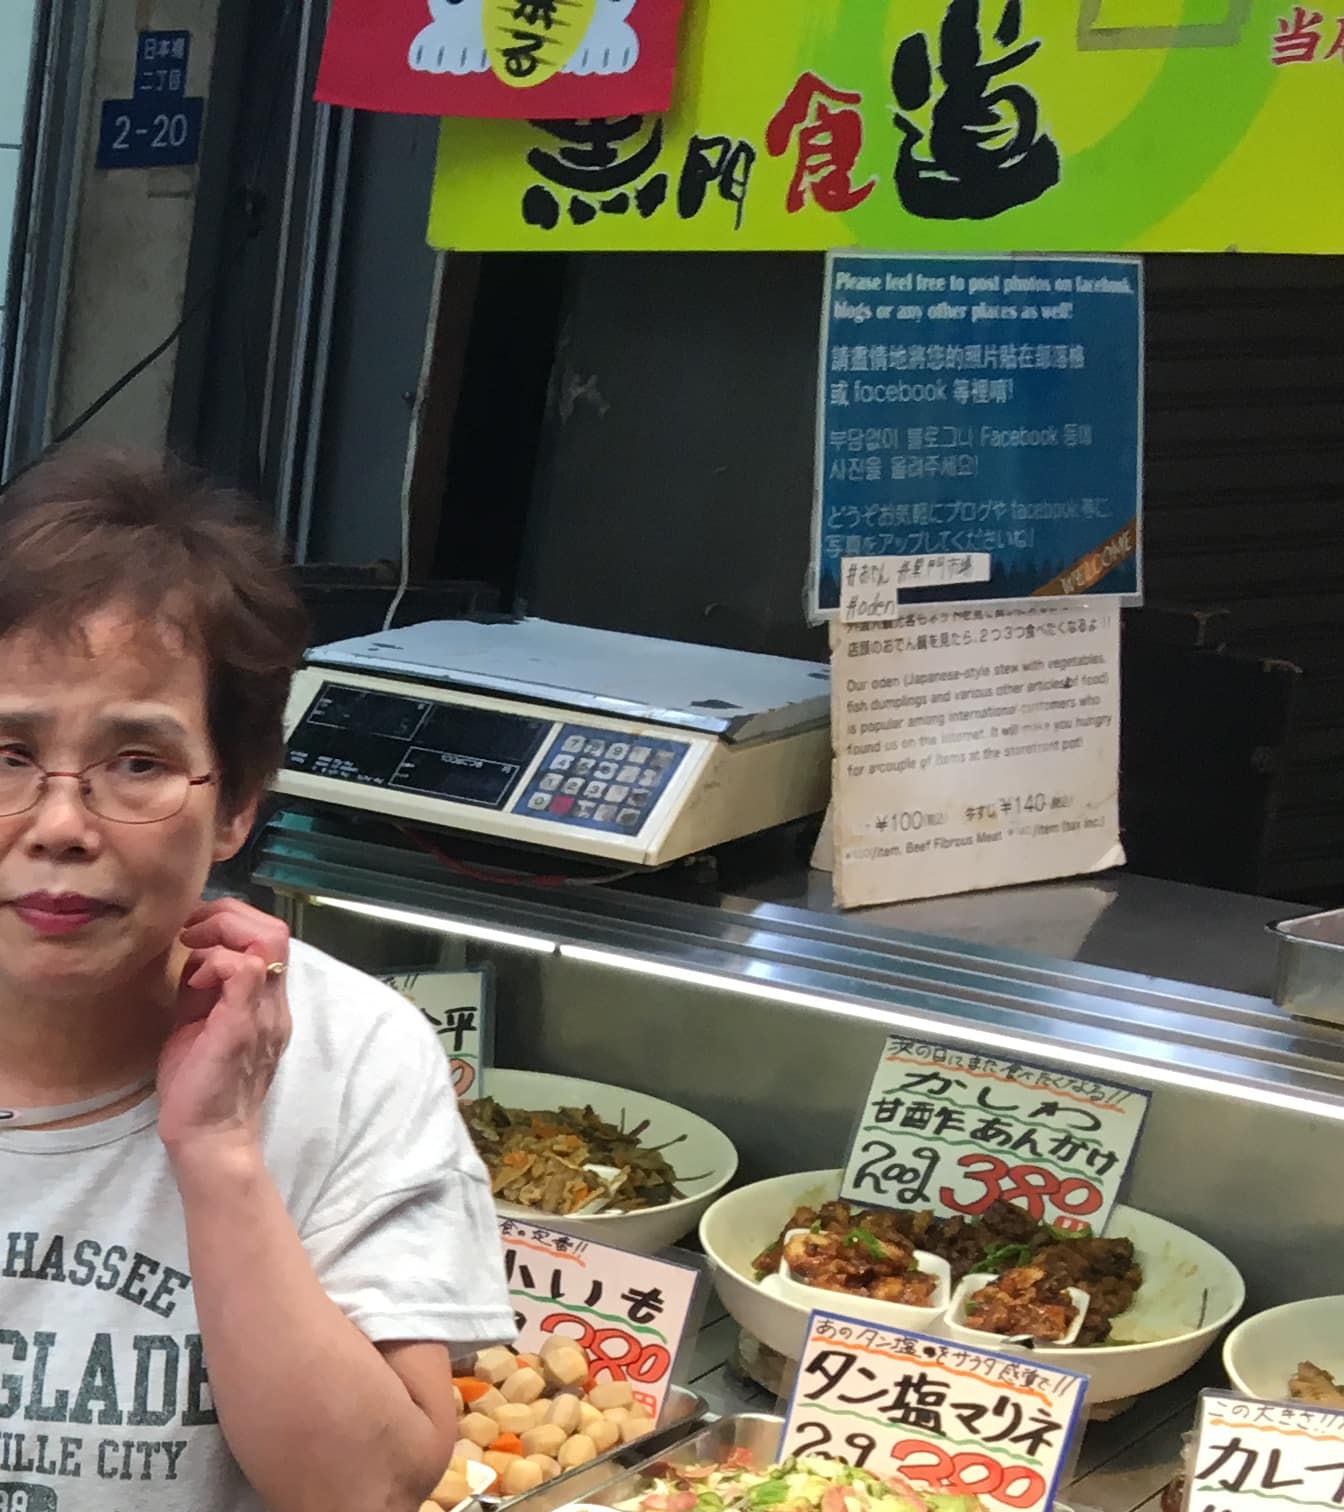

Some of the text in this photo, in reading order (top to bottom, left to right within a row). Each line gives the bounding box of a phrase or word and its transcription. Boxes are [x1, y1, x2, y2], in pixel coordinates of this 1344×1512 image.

[140, 69, 181, 91] 二丁目
[112, 113, 188, 150] 2-20
[835, 272, 882, 291] Please
[854, 377, 945, 402] facebook
[979, 424, 1058, 449] Facebook
[1060, 531, 1134, 596] WELCOME
[847, 678, 869, 693] Our
[871, 676, 900, 690] oden
[1022, 659, 1046, 673] with
[871, 691, 928, 712] dumplings
[931, 690, 951, 704] and
[996, 682, 1024, 697] other
[860, 716, 903, 736] popular
[1079, 694, 1101, 708] who
[1075, 713, 1112, 733] hungry
[847, 764, 864, 778] for
[905, 840, 931, 855] Beef
[976, 829, 1003, 844] Meat
[901, 1071, 1102, 1132] かしわ
[802, 1348, 1065, 1458] タン塩マリネ
[97, 1438, 188, 1481] CITY
